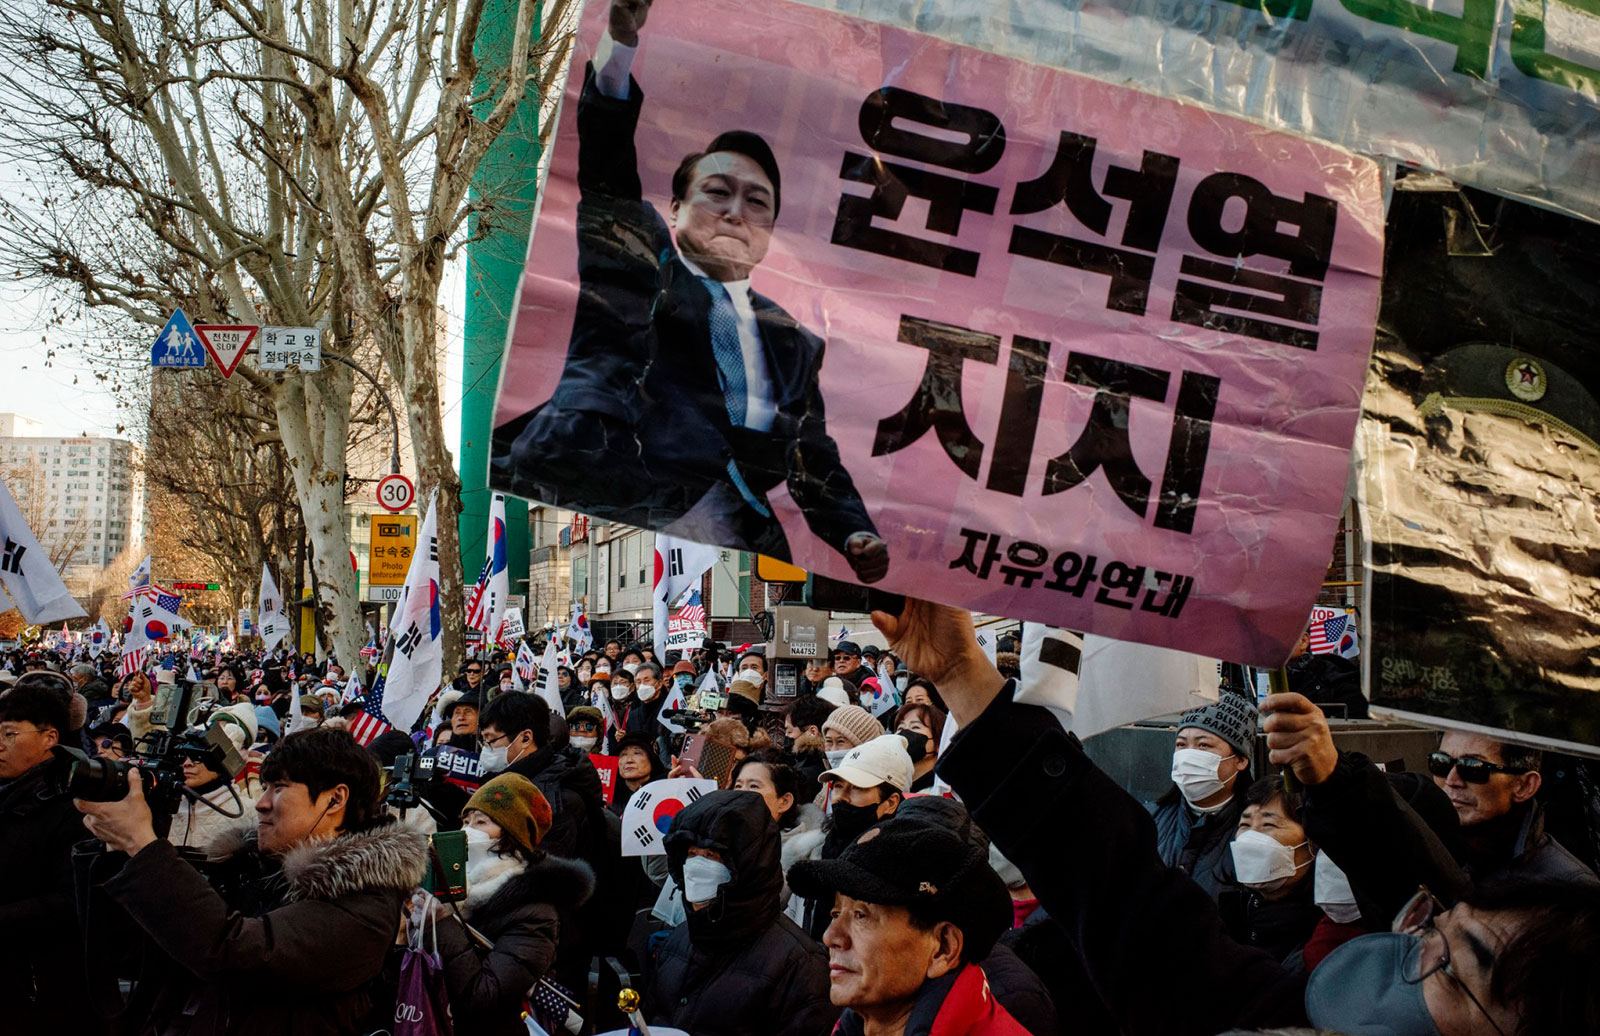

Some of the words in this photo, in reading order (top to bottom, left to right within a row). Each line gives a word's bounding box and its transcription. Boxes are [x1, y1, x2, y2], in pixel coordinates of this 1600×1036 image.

[831, 86, 1338, 351] 윤석열
[212, 333, 240, 343] 천천히
[216, 343, 237, 351] SLOW
[159, 356, 199, 365] 어린이보호
[265, 351, 315, 365] 절대감속
[871, 314, 1221, 535] 지지
[384, 485, 407, 501] 30
[374, 546, 411, 559] 단속중
[382, 562, 404, 570] Photo
[949, 528, 1195, 620] 자유와연대
[1311, 609, 1335, 620] TOP
[1223, 695, 1246, 713] BLUE
[1215, 711, 1243, 731] BLUE
[1216, 703, 1249, 725] ANANA
[1202, 717, 1245, 745] BANANA
[437, 751, 488, 778] 헌법대
